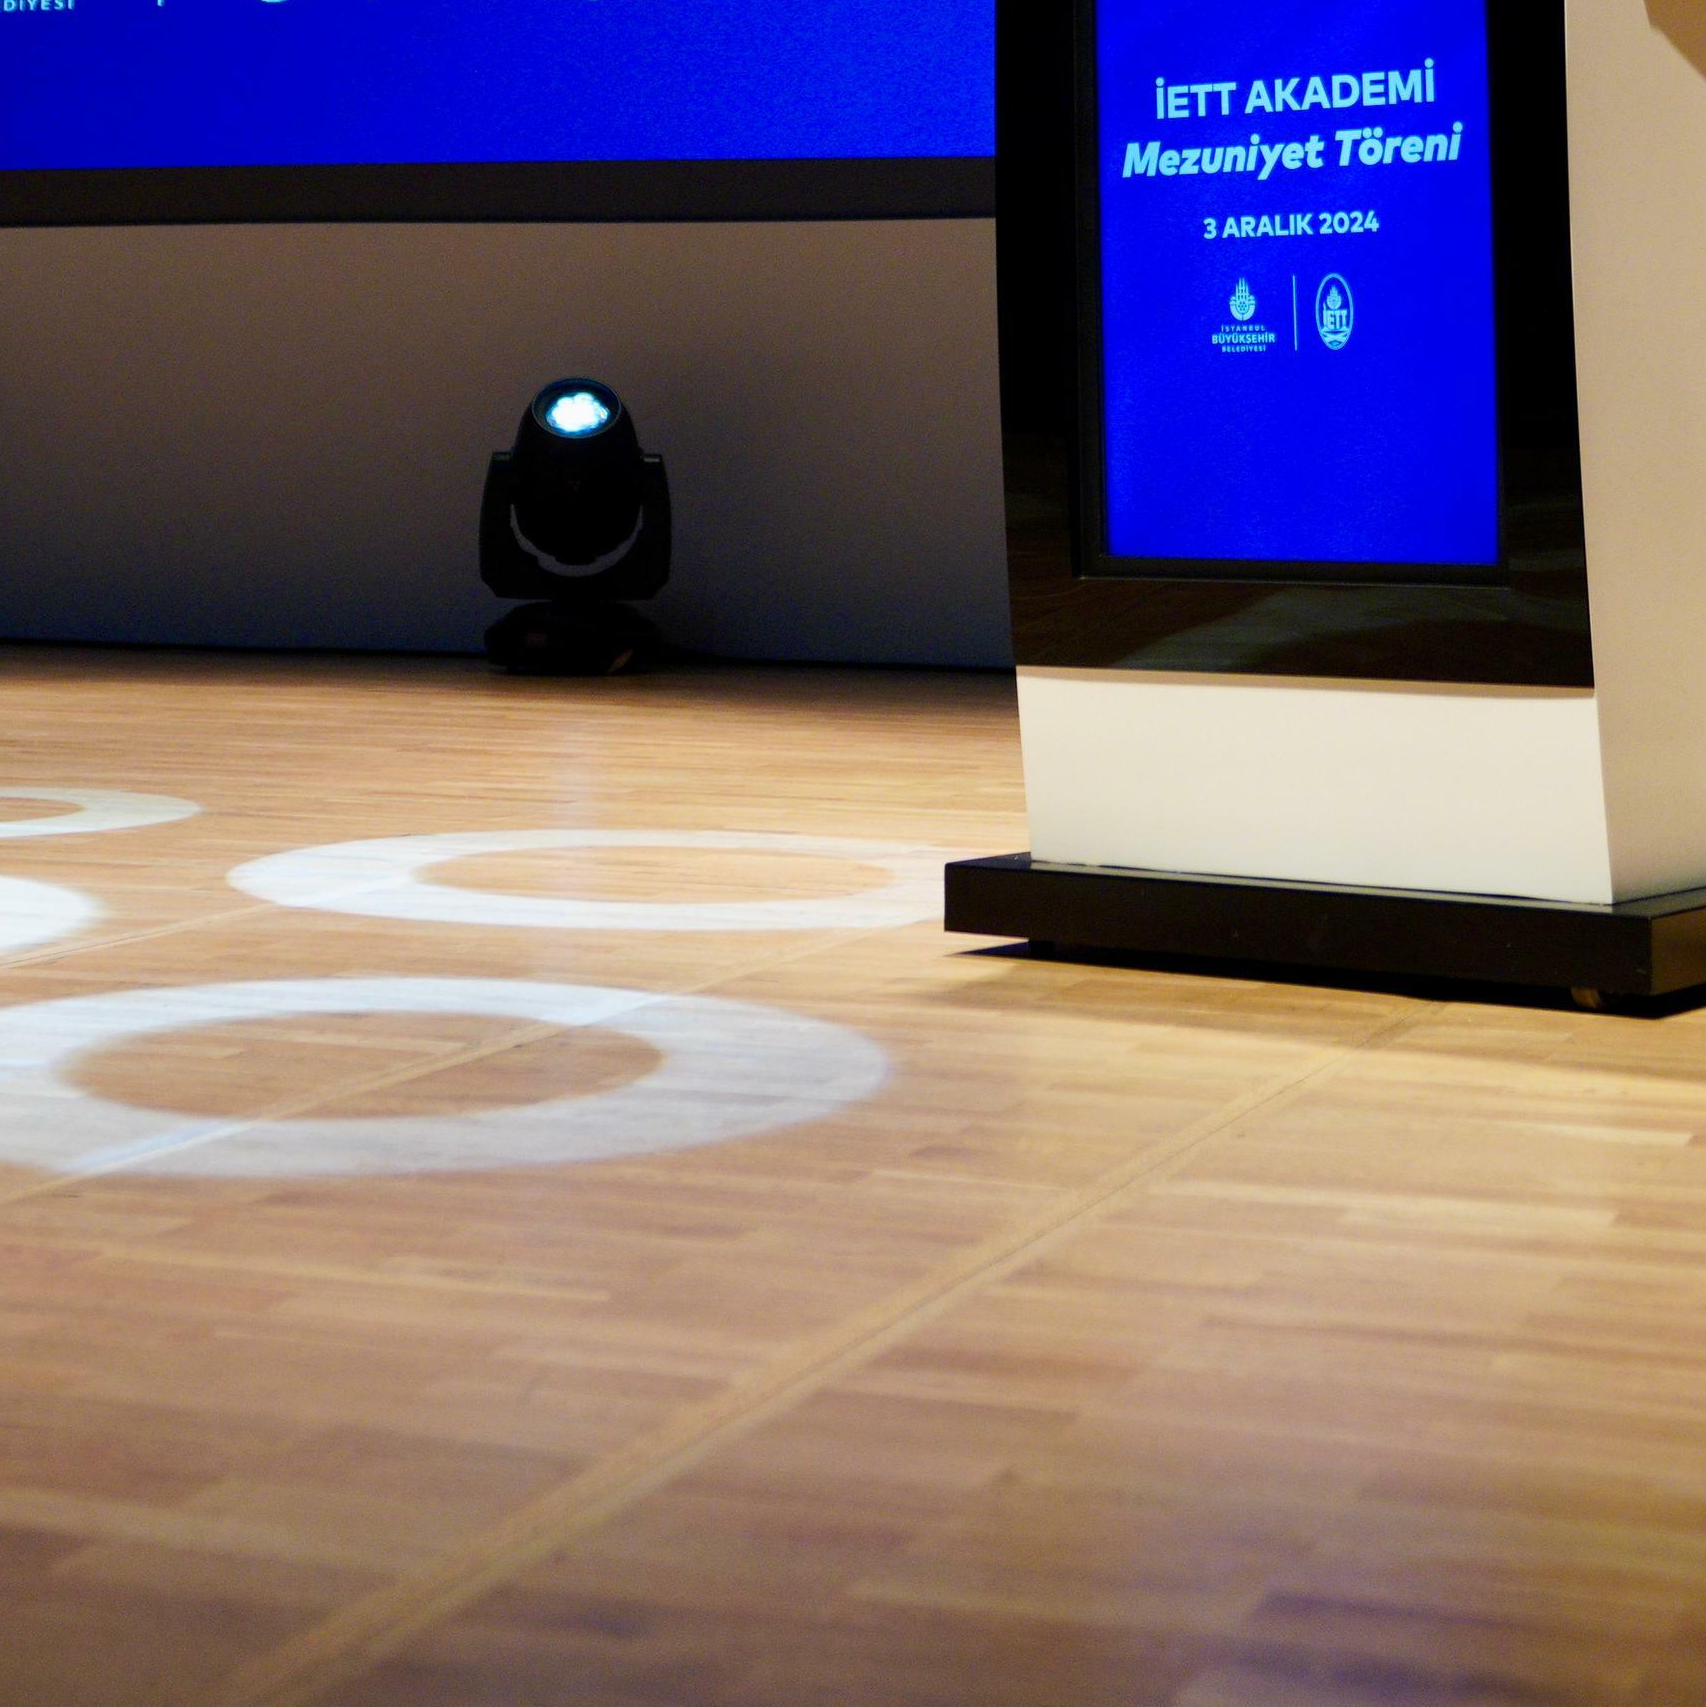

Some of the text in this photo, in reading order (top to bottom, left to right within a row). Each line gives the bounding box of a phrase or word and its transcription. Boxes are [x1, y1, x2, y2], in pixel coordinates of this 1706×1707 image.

[1156, 58, 1434, 119] İETT AKADEMİ
[1123, 122, 1463, 180] Mezuniyet Töreni
[1204, 211, 1379, 239] 3 ARALIK 2024
